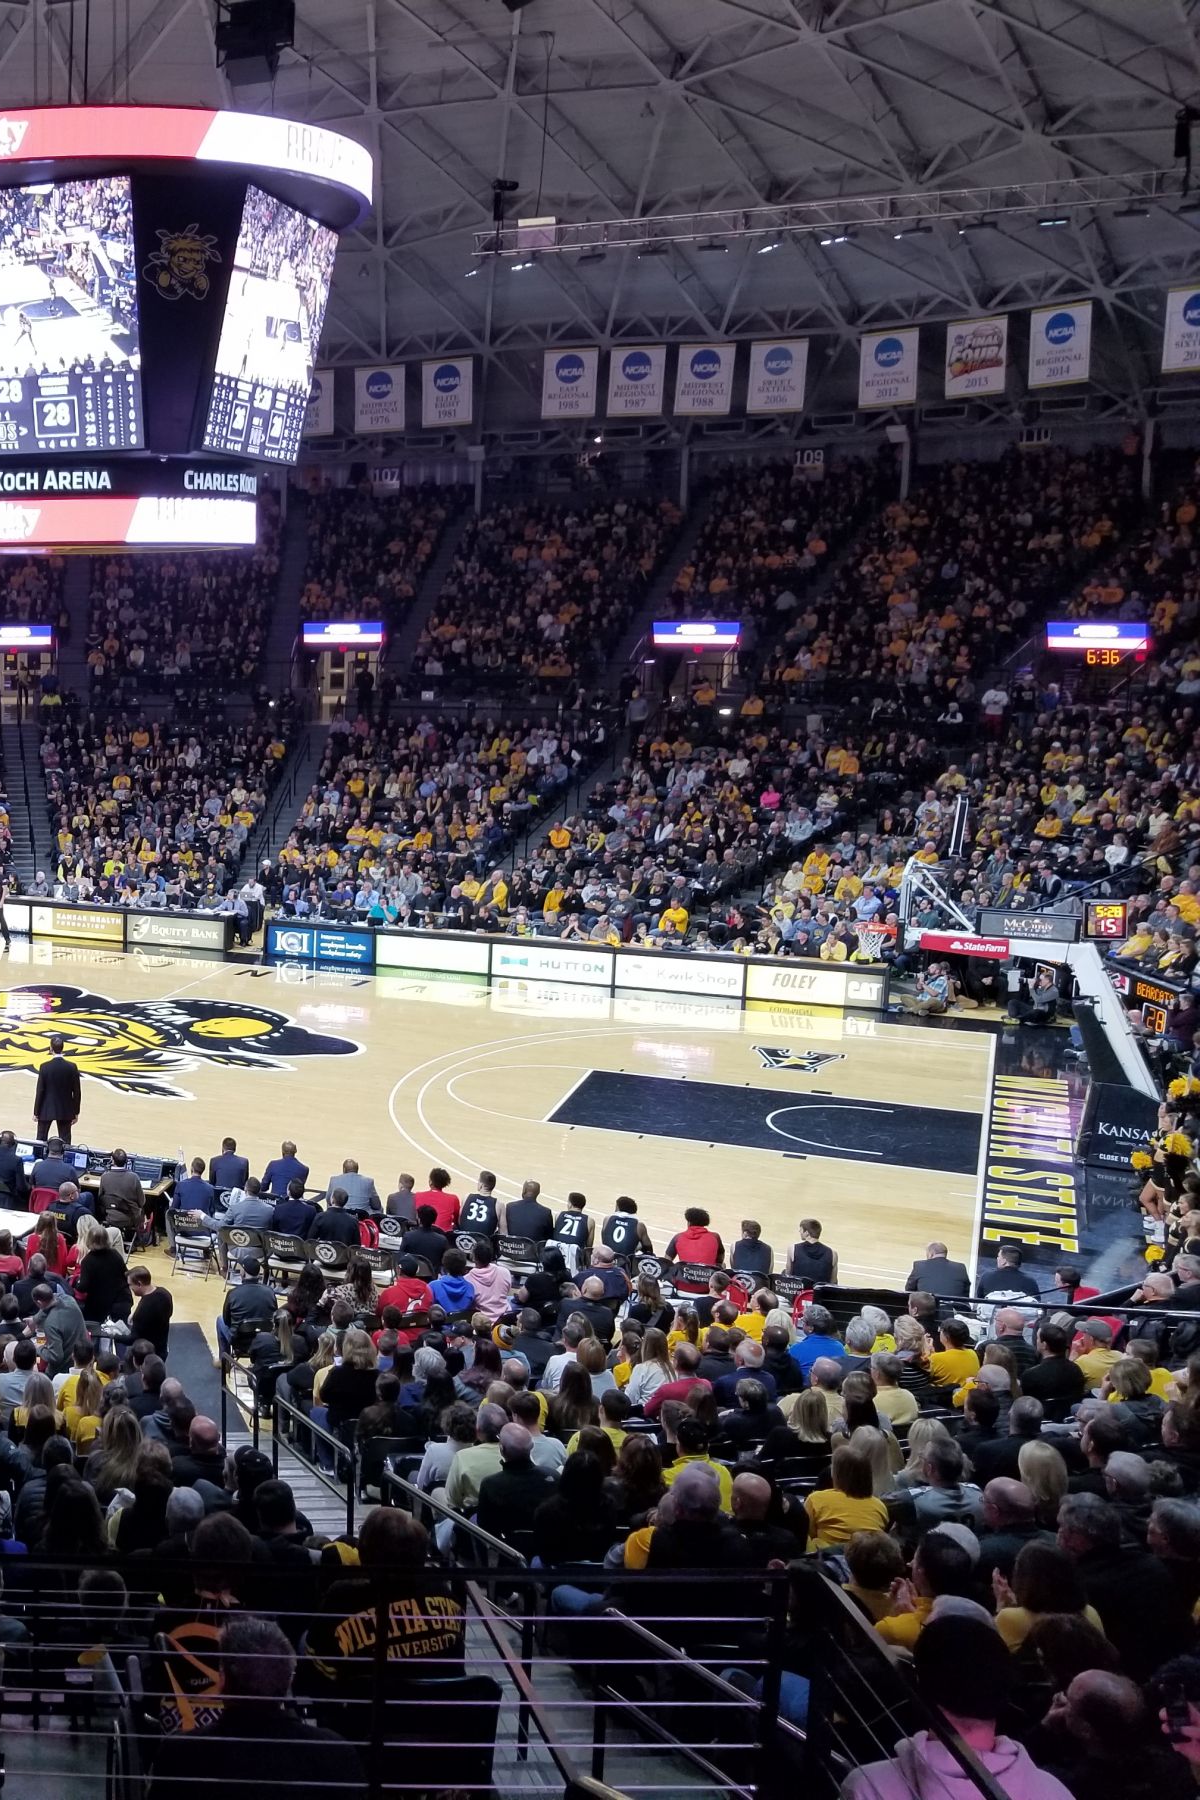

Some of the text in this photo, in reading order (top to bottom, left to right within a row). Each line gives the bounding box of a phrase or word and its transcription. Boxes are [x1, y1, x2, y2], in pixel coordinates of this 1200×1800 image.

[1048, 325, 1075, 337] NCAA
[963, 331, 999, 347] FINAL
[877, 351, 903, 361] NCAA
[948, 345, 1001, 367] FOUR
[1035, 353, 1084, 366] REGIONAL
[692, 364, 721, 373] NCAA
[766, 360, 793, 369] NCAA
[558, 367, 585, 376] NCAA
[624, 366, 653, 376] NCAA
[1046, 365, 1071, 378] 2014
[436, 377, 461, 387] NCAA
[616, 383, 656, 391] MIDWEST
[683, 381, 725, 390] MIDWEST
[762, 378, 792, 387] SWEET
[865, 376, 911, 388] REGIONAL
[964, 376, 989, 389] 2013
[368, 383, 393, 393] NCAA
[613, 389, 658, 398] REGIONAL
[680, 388, 726, 396] REGIONAL
[757, 385, 795, 393] SIXTEEN
[875, 386, 899, 398] 2012
[548, 391, 590, 399] REGIONAL
[361, 401, 398, 409] MIDWEST
[434, 400, 461, 409] EIGHT
[557, 400, 580, 410] 1985
[623, 398, 647, 408] 1987
[42, 402, 71, 427] 28
[359, 407, 400, 416] REGIONAL
[437, 409, 457, 419] 1981
[369, 416, 390, 425] 1976
[795, 449, 824, 465] 109
[43, 470, 112, 490] ARENA
[373, 468, 399, 482] 107
[184, 470, 239, 492] CHARLES
[1086, 649, 1120, 665] 6:36
[1096, 905, 1124, 918] 5:28
[56, 913, 122, 925] KANSAS HEALTH
[151, 924, 219, 940] EQUITY BANK
[1099, 919, 1117, 934] 15
[274, 930, 310, 953] ICI
[320, 942, 345, 950] employee
[539, 959, 605, 973] HUTTON
[656, 967, 738, 988] Kwik Shop
[771, 972, 817, 990] FOLEY
[1136, 982, 1175, 1003] BEARCATS
[1146, 1007, 1164, 1033] 28
[1098, 1121, 1150, 1141] KANSA
[1099, 1153, 1119, 1162] CLOSE
[983, 1074, 1079, 1253] WICHITA STATE
[467, 1202, 488, 1222] 33
[173, 1220, 199, 1229] Federal
[559, 1218, 579, 1236] 21
[612, 1226, 626, 1243] 0
[269, 1237, 294, 1247] Capitol
[269, 1243, 295, 1252] Federal
[498, 1240, 525, 1250] Capitol
[355, 1251, 382, 1261] Capitol
[499, 1246, 526, 1255] Federal
[683, 1267, 711, 1277] Capitol
[774, 1279, 804, 1290] Capitol
[334, 1598, 429, 1657] WICITA
[386, 1633, 457, 1661] NIVERSITY
